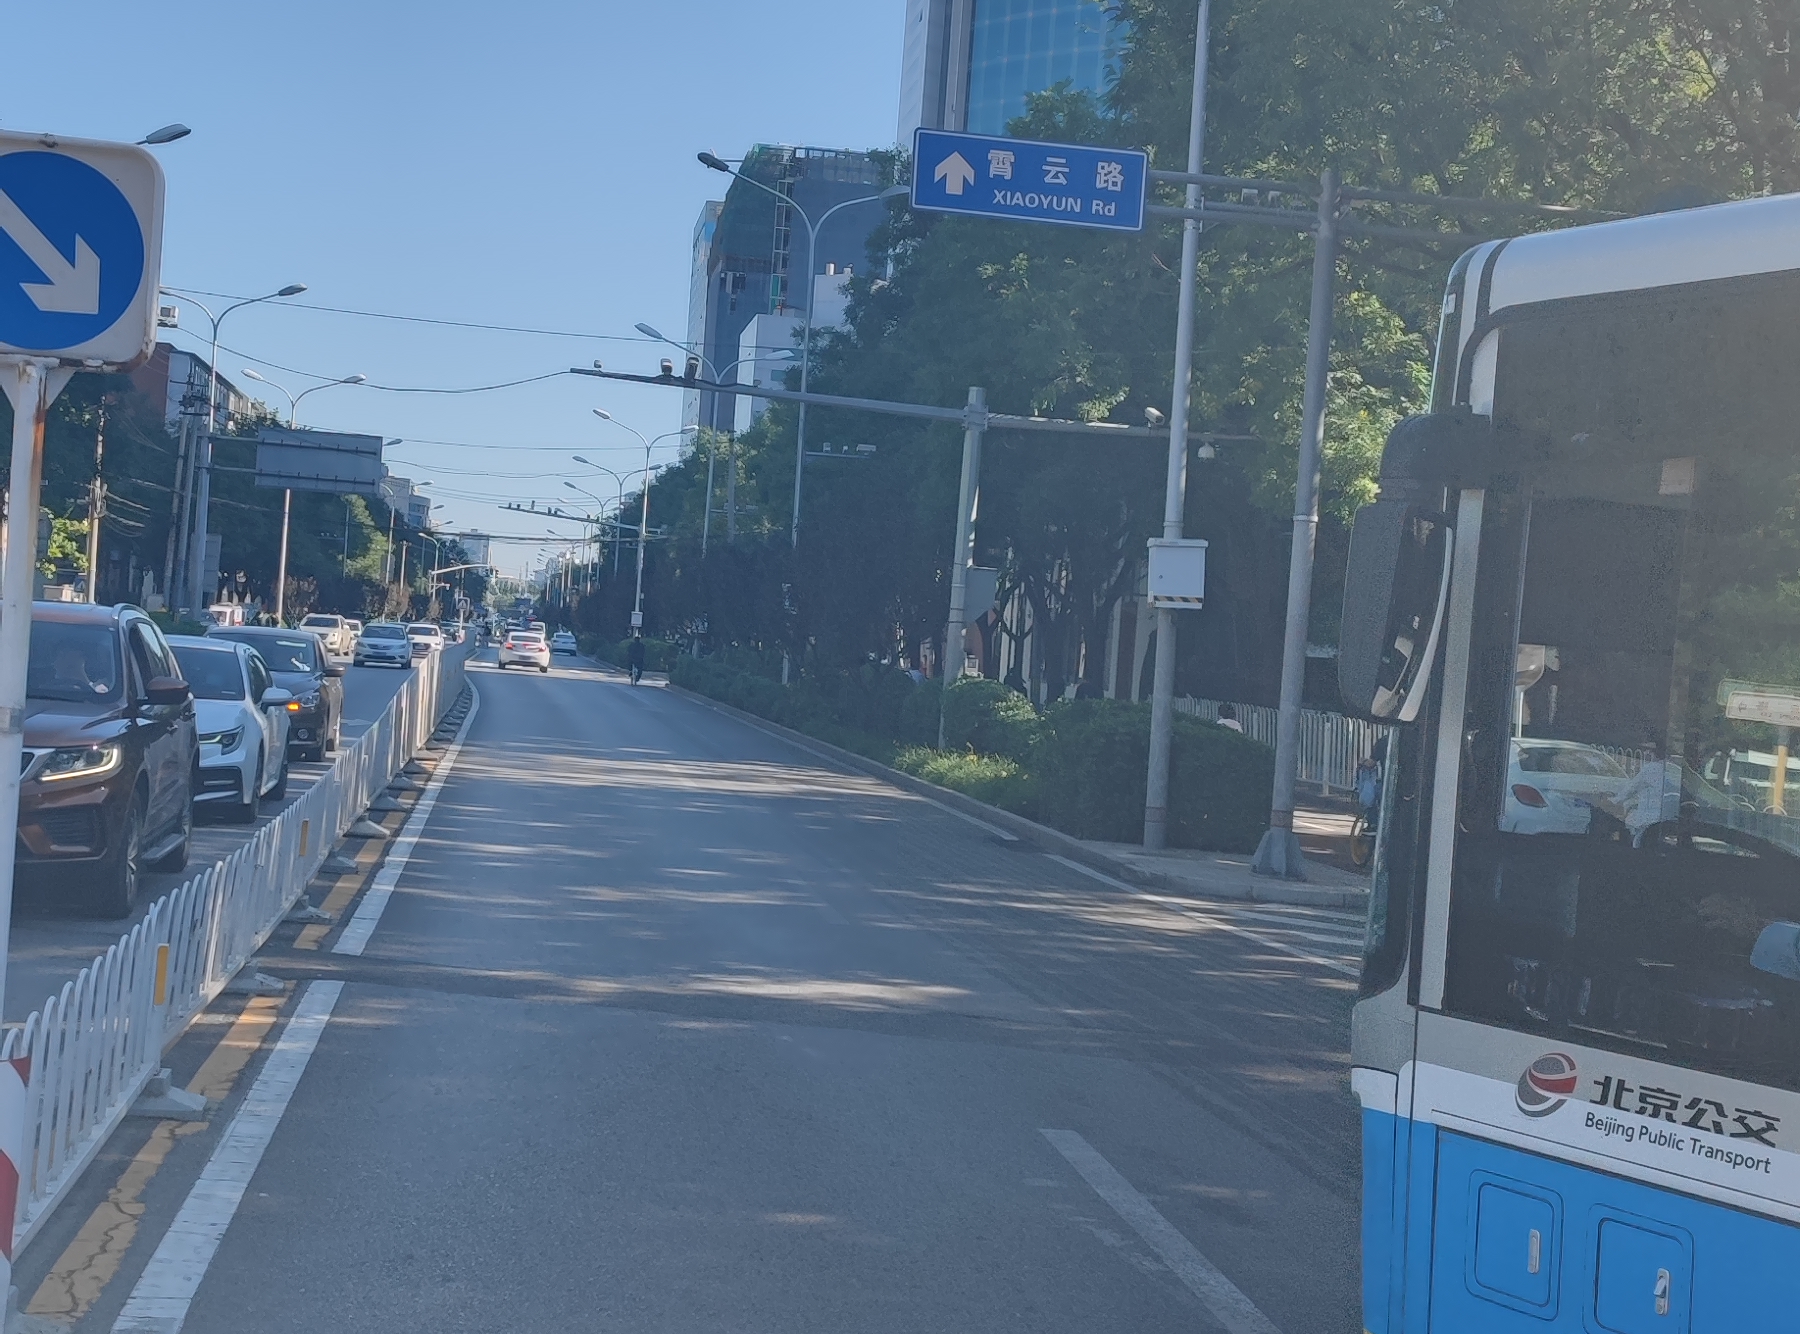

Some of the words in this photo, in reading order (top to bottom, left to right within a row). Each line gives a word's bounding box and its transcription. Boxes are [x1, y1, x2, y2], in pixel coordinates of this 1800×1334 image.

[987, 149, 1125, 192] 霄云路
[992, 189, 1082, 213] XIAOYUN
[1091, 199, 1116, 217] Rd
[1589, 1075, 1781, 1149] 北京公交
[1584, 1111, 1635, 1143] Beijing
[1638, 1125, 1686, 1151] Public
[1689, 1137, 1772, 1174] Transport
